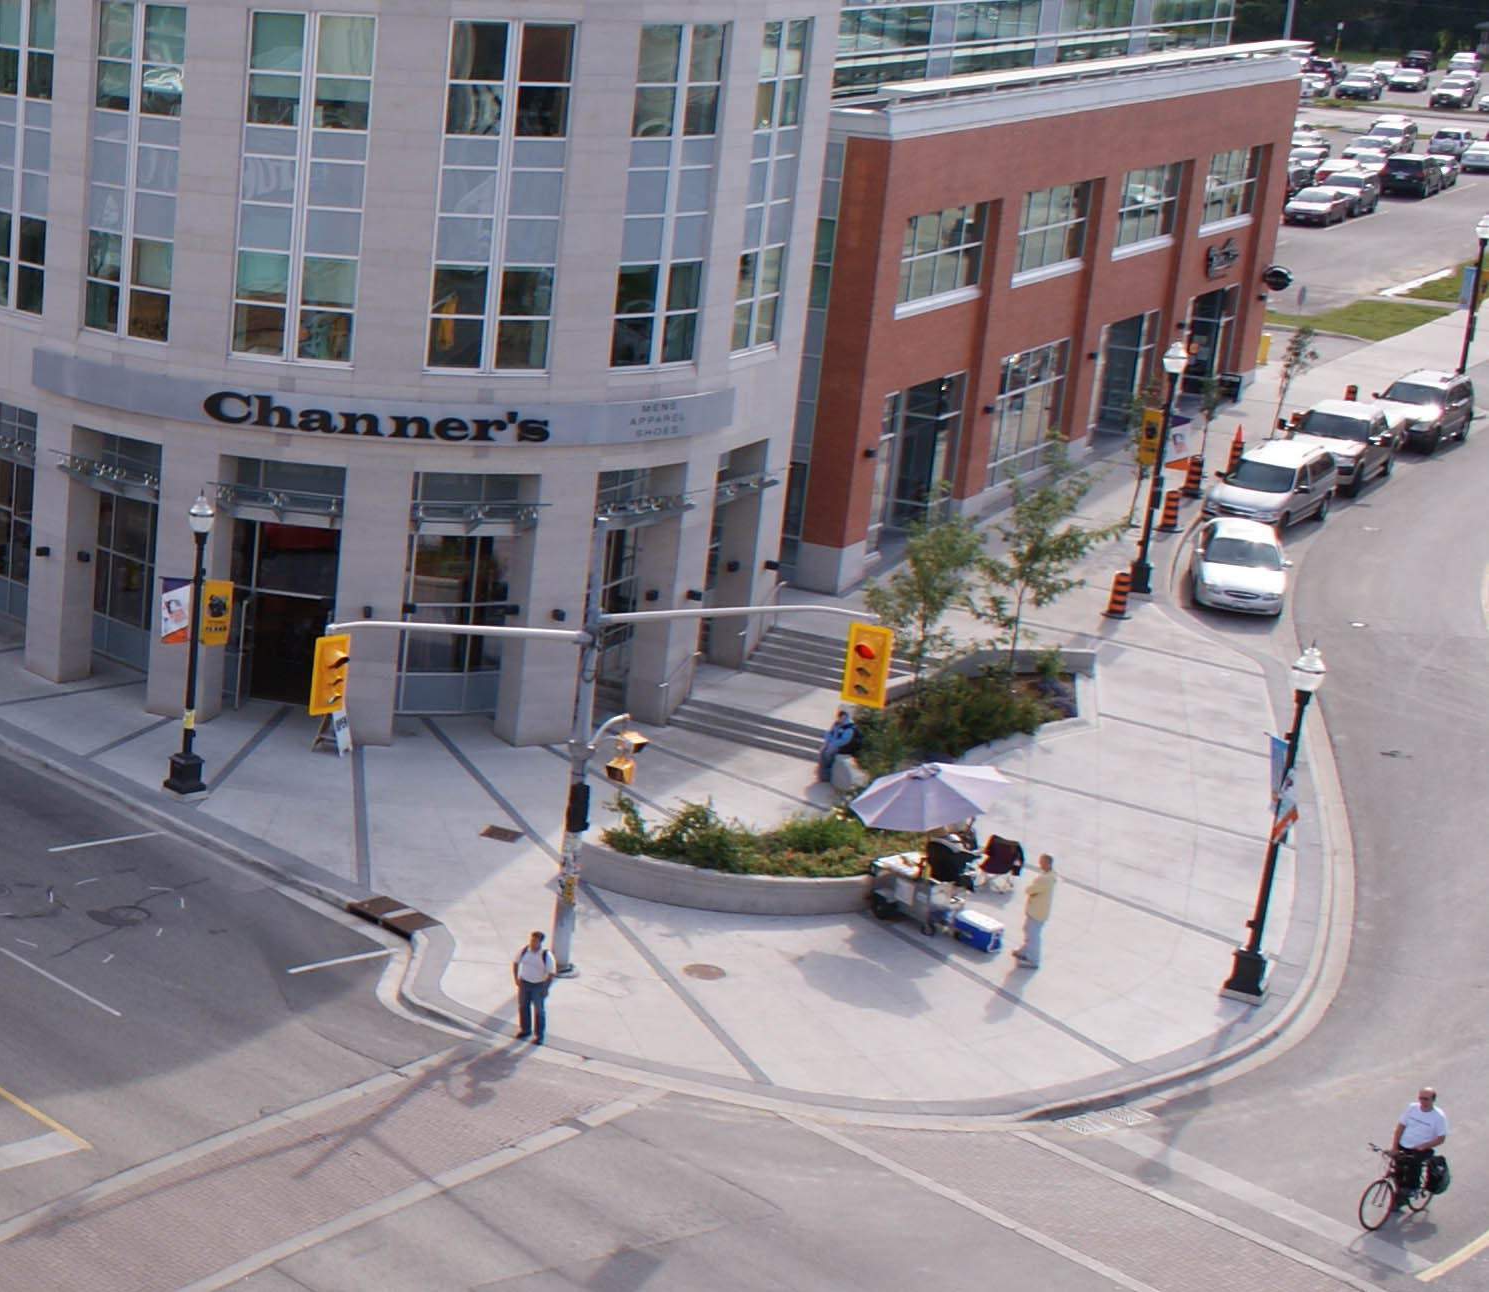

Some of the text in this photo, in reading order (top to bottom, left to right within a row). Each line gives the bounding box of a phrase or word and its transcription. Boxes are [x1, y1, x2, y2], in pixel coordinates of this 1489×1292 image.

[641, 401, 678, 413] MENS
[203, 391, 551, 442] Channer's
[629, 413, 686, 425] APPAREL
[636, 425, 679, 438] SHOES
